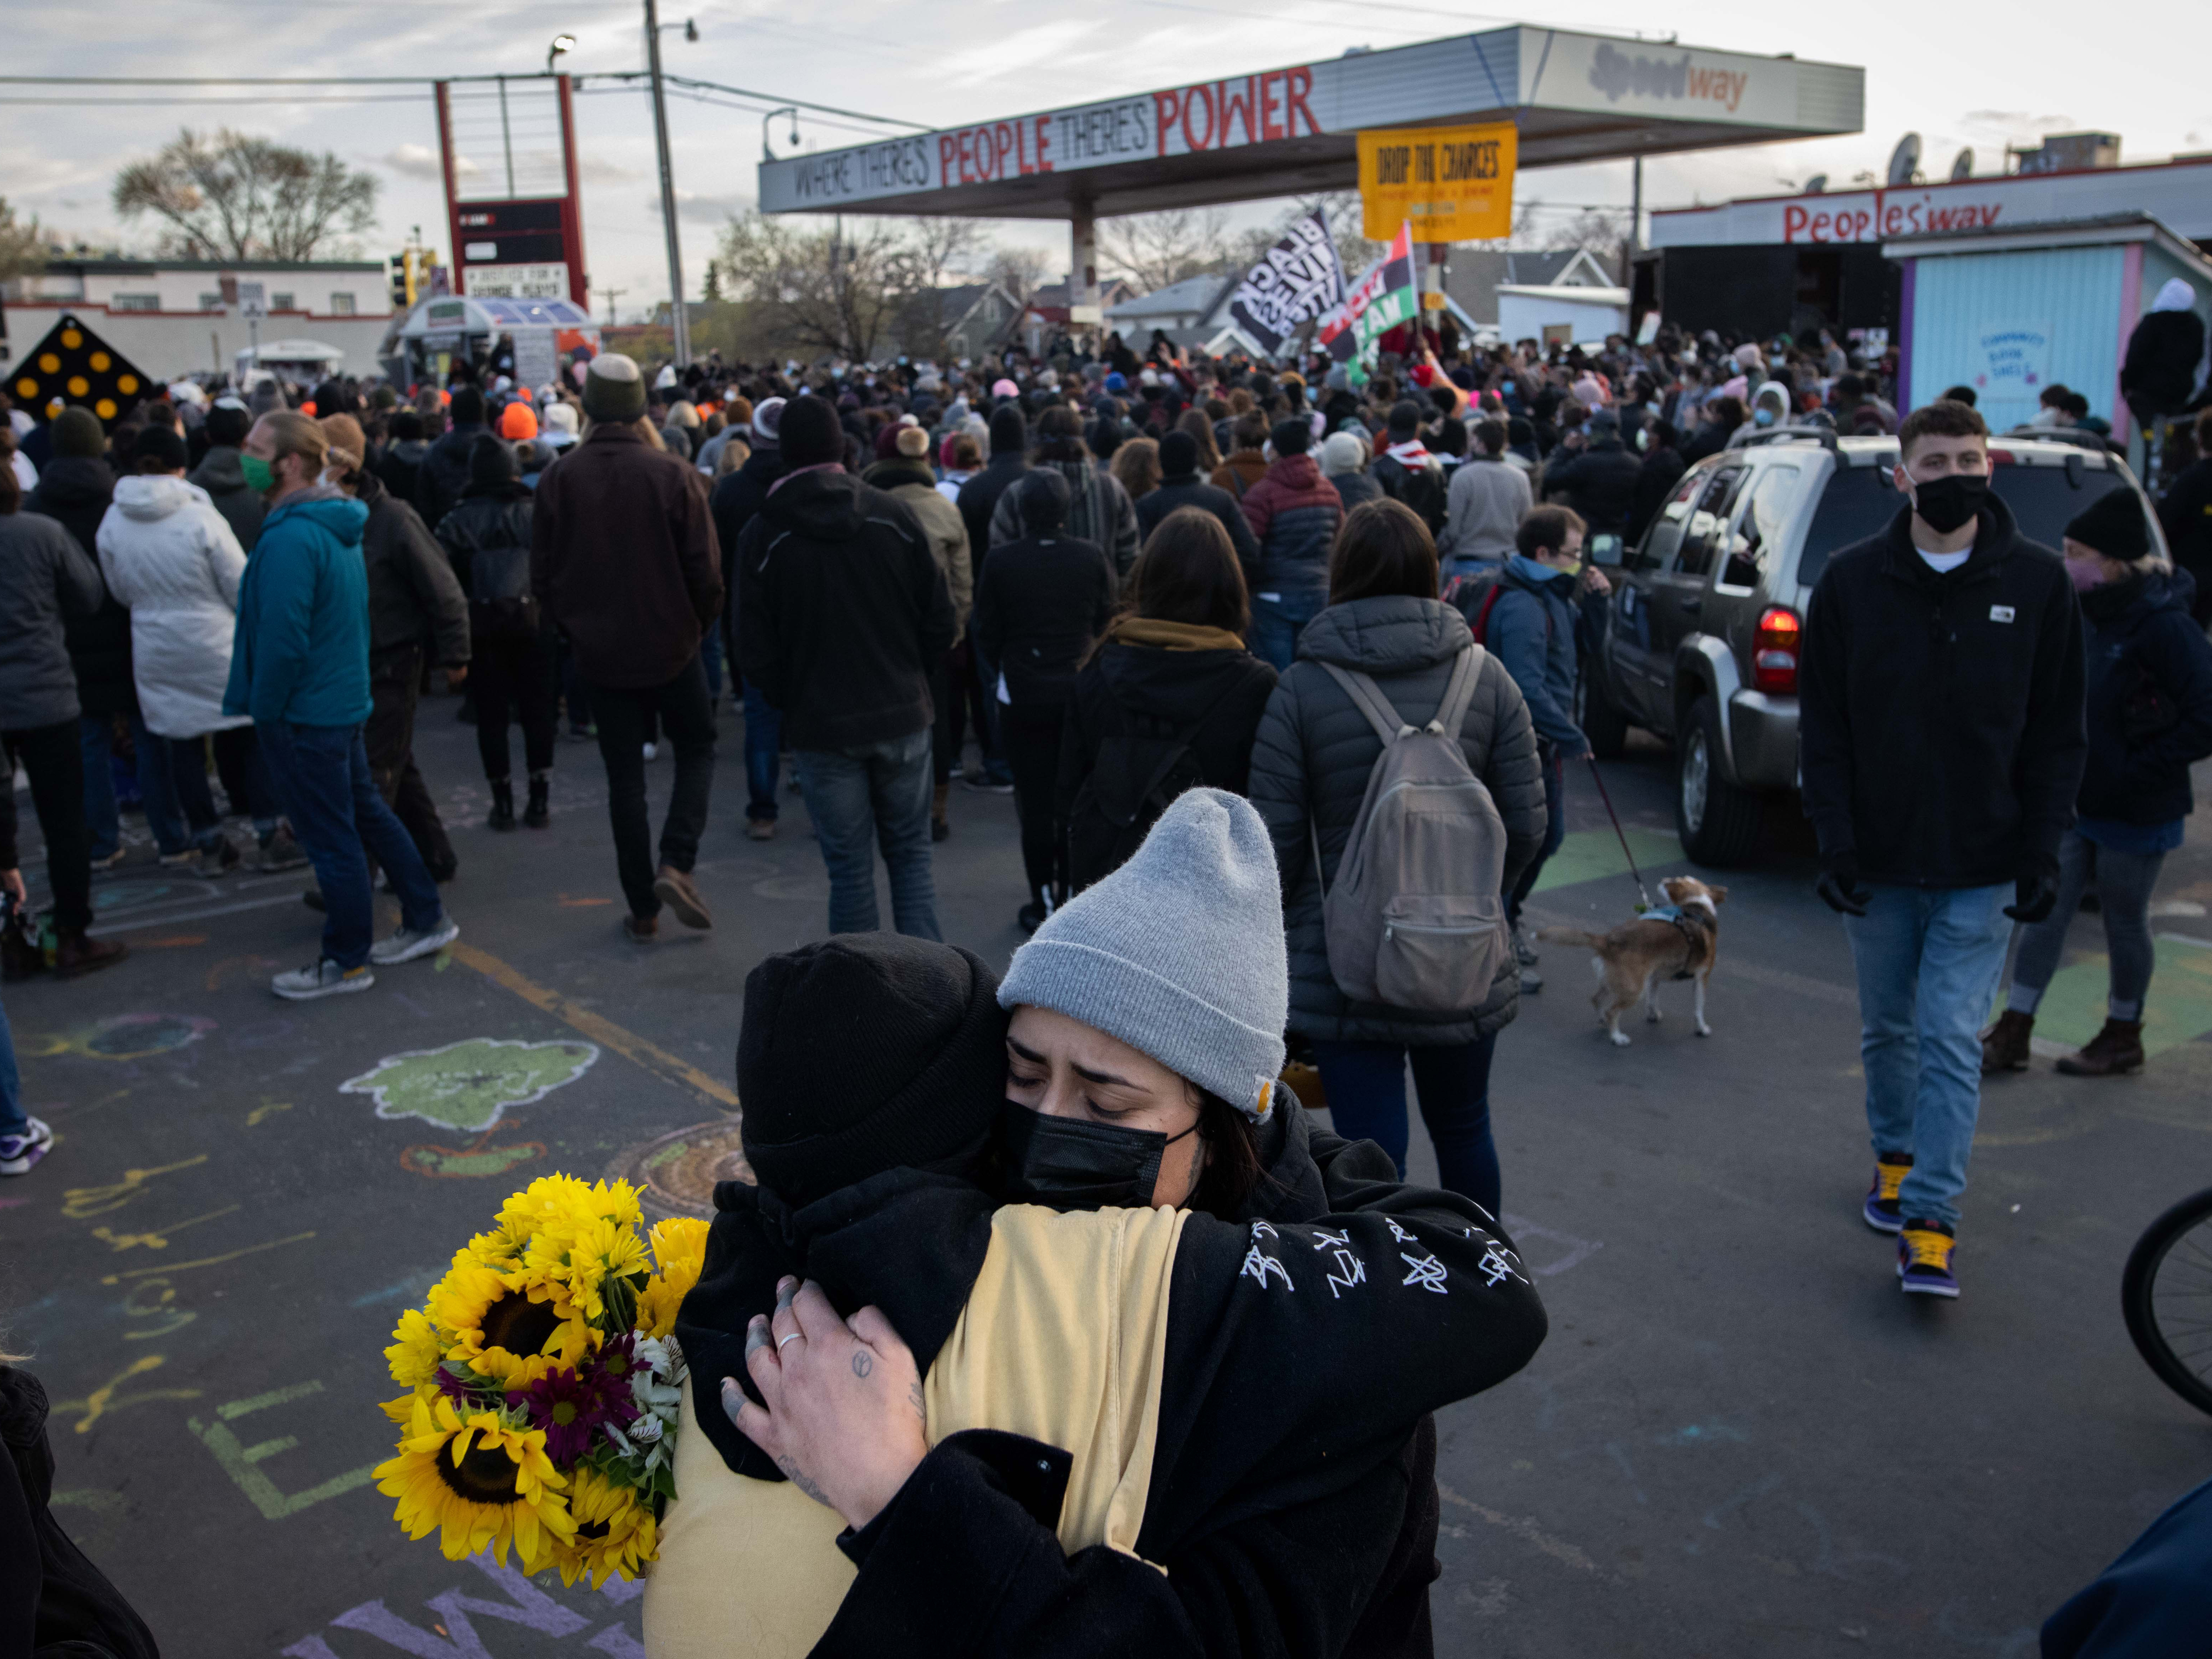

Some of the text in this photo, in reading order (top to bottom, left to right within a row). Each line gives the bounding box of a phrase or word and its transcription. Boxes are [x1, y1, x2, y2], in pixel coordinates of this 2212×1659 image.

[795, 65, 1322, 197] WHERE THERES PEOPLE THERES POWER
